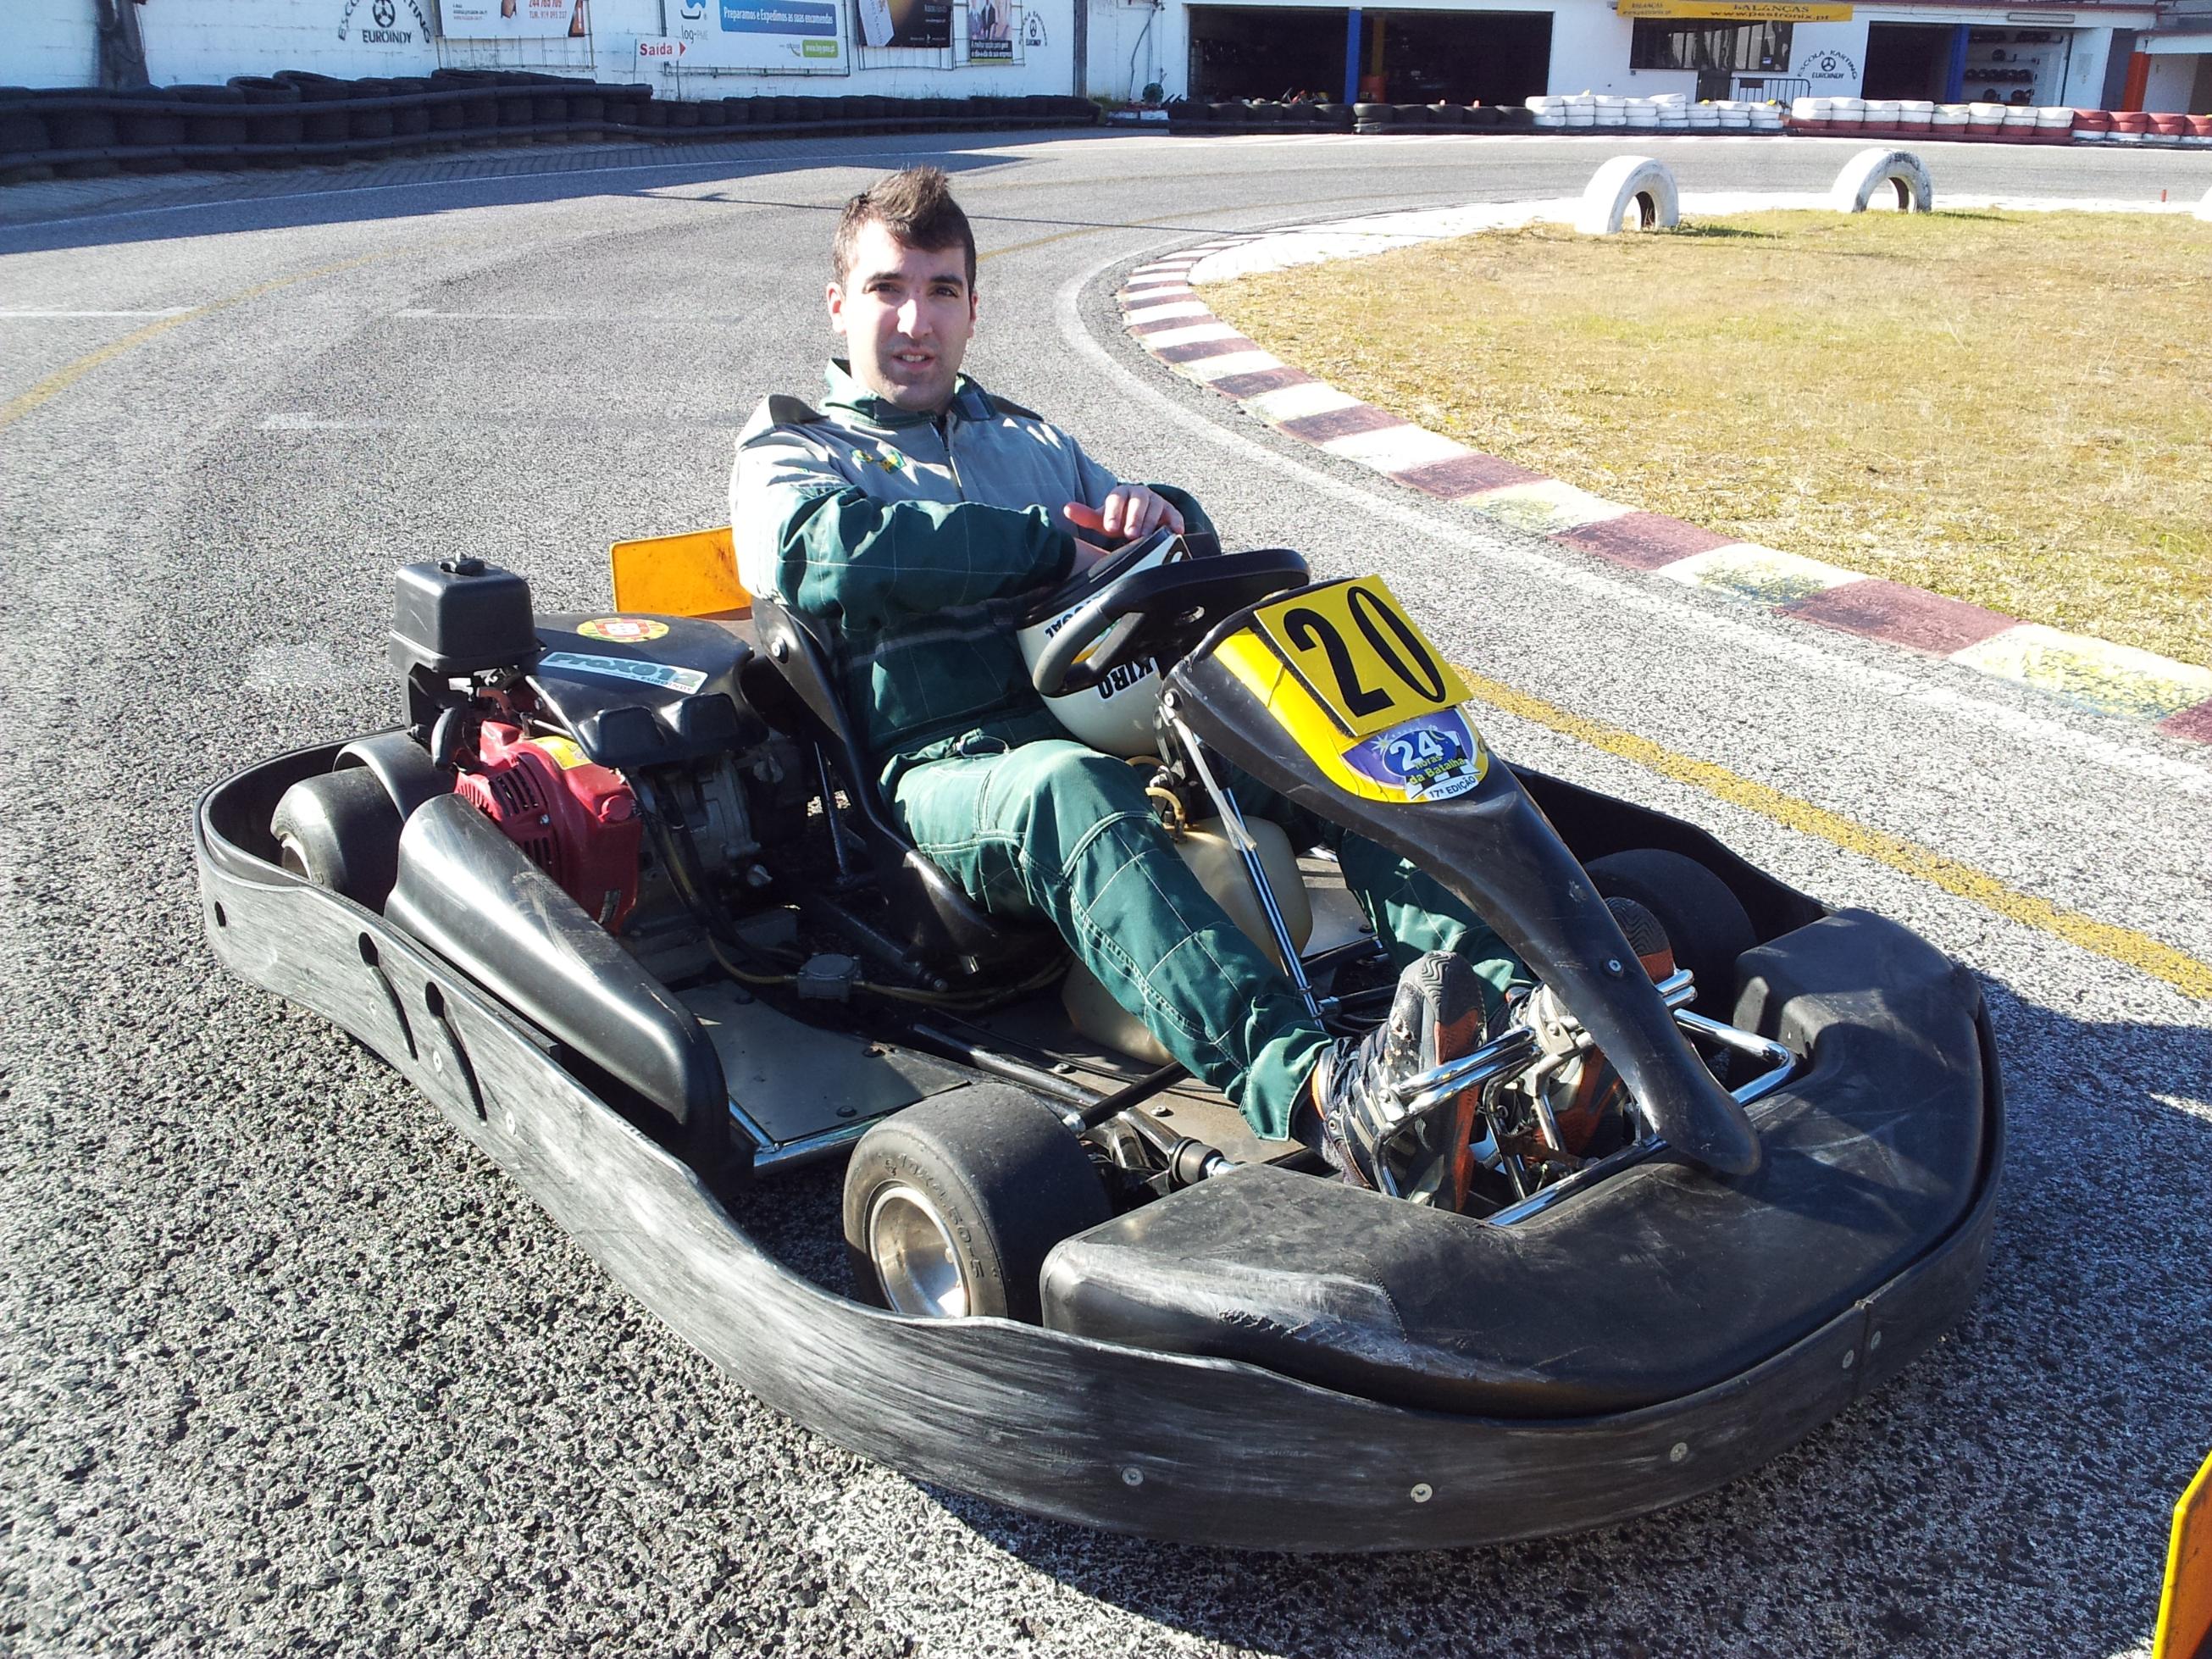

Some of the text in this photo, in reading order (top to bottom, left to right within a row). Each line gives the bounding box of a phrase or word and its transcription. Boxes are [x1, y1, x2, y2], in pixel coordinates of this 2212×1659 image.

[362, 29, 413, 43] EUROINDY
[1283, 586, 1446, 718] 20
[1389, 730, 1444, 772] 24
[1409, 757, 1466, 785] da Batalha
[1447, 775, 1477, 795] EDIÇÃO
